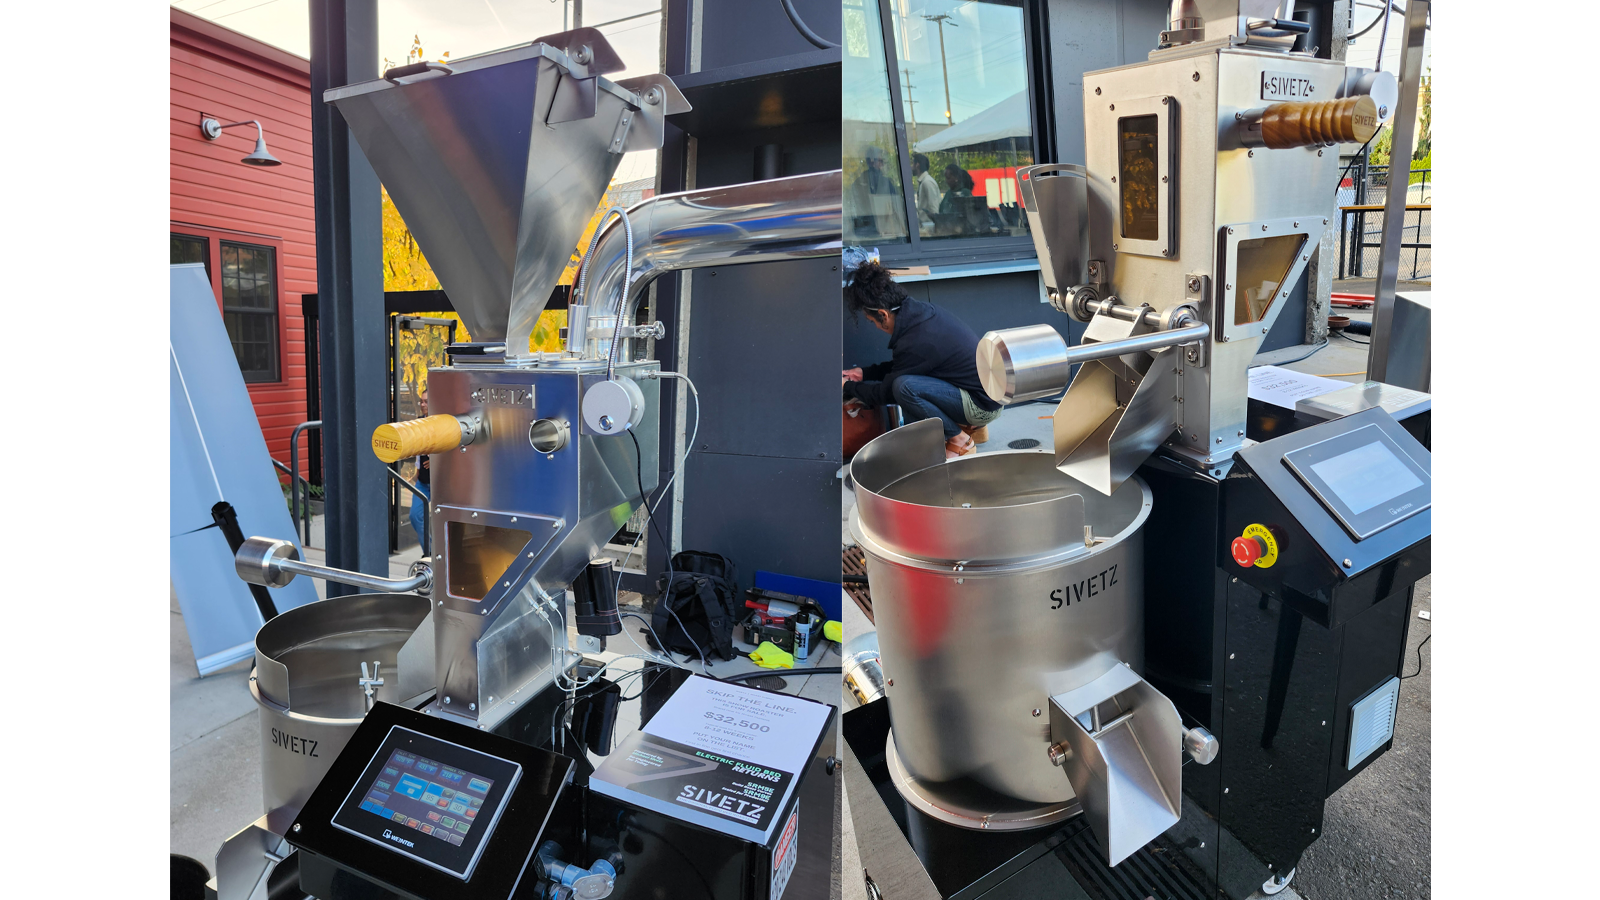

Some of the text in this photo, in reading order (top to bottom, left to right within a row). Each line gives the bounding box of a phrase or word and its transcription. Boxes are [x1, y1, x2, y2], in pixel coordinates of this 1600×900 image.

[1270, 76, 1310, 97] SIVETZ
[1354, 115, 1376, 127] SIVETZ
[477, 387, 526, 405] SIVETZ
[374, 439, 398, 451] SIVETZ
[1049, 563, 1118, 610] SIVETZ
[706, 688, 735, 698] SKIP
[738, 696, 762, 706] THE
[703, 711, 770, 733] $32,500
[271, 727, 319, 758] SIVETZ
[710, 735, 731, 744] YOUR
[733, 740, 756, 750] NAME
[723, 729, 755, 741] WEEKS
[695, 751, 782, 778] ELECTRIC FLUID BED
[731, 765, 780, 783] RETURNS
[426, 794, 434, 802] 95
[453, 803, 462, 811] 30
[680, 784, 766, 819] SIVETZ
[391, 834, 415, 848] WEINTEK
